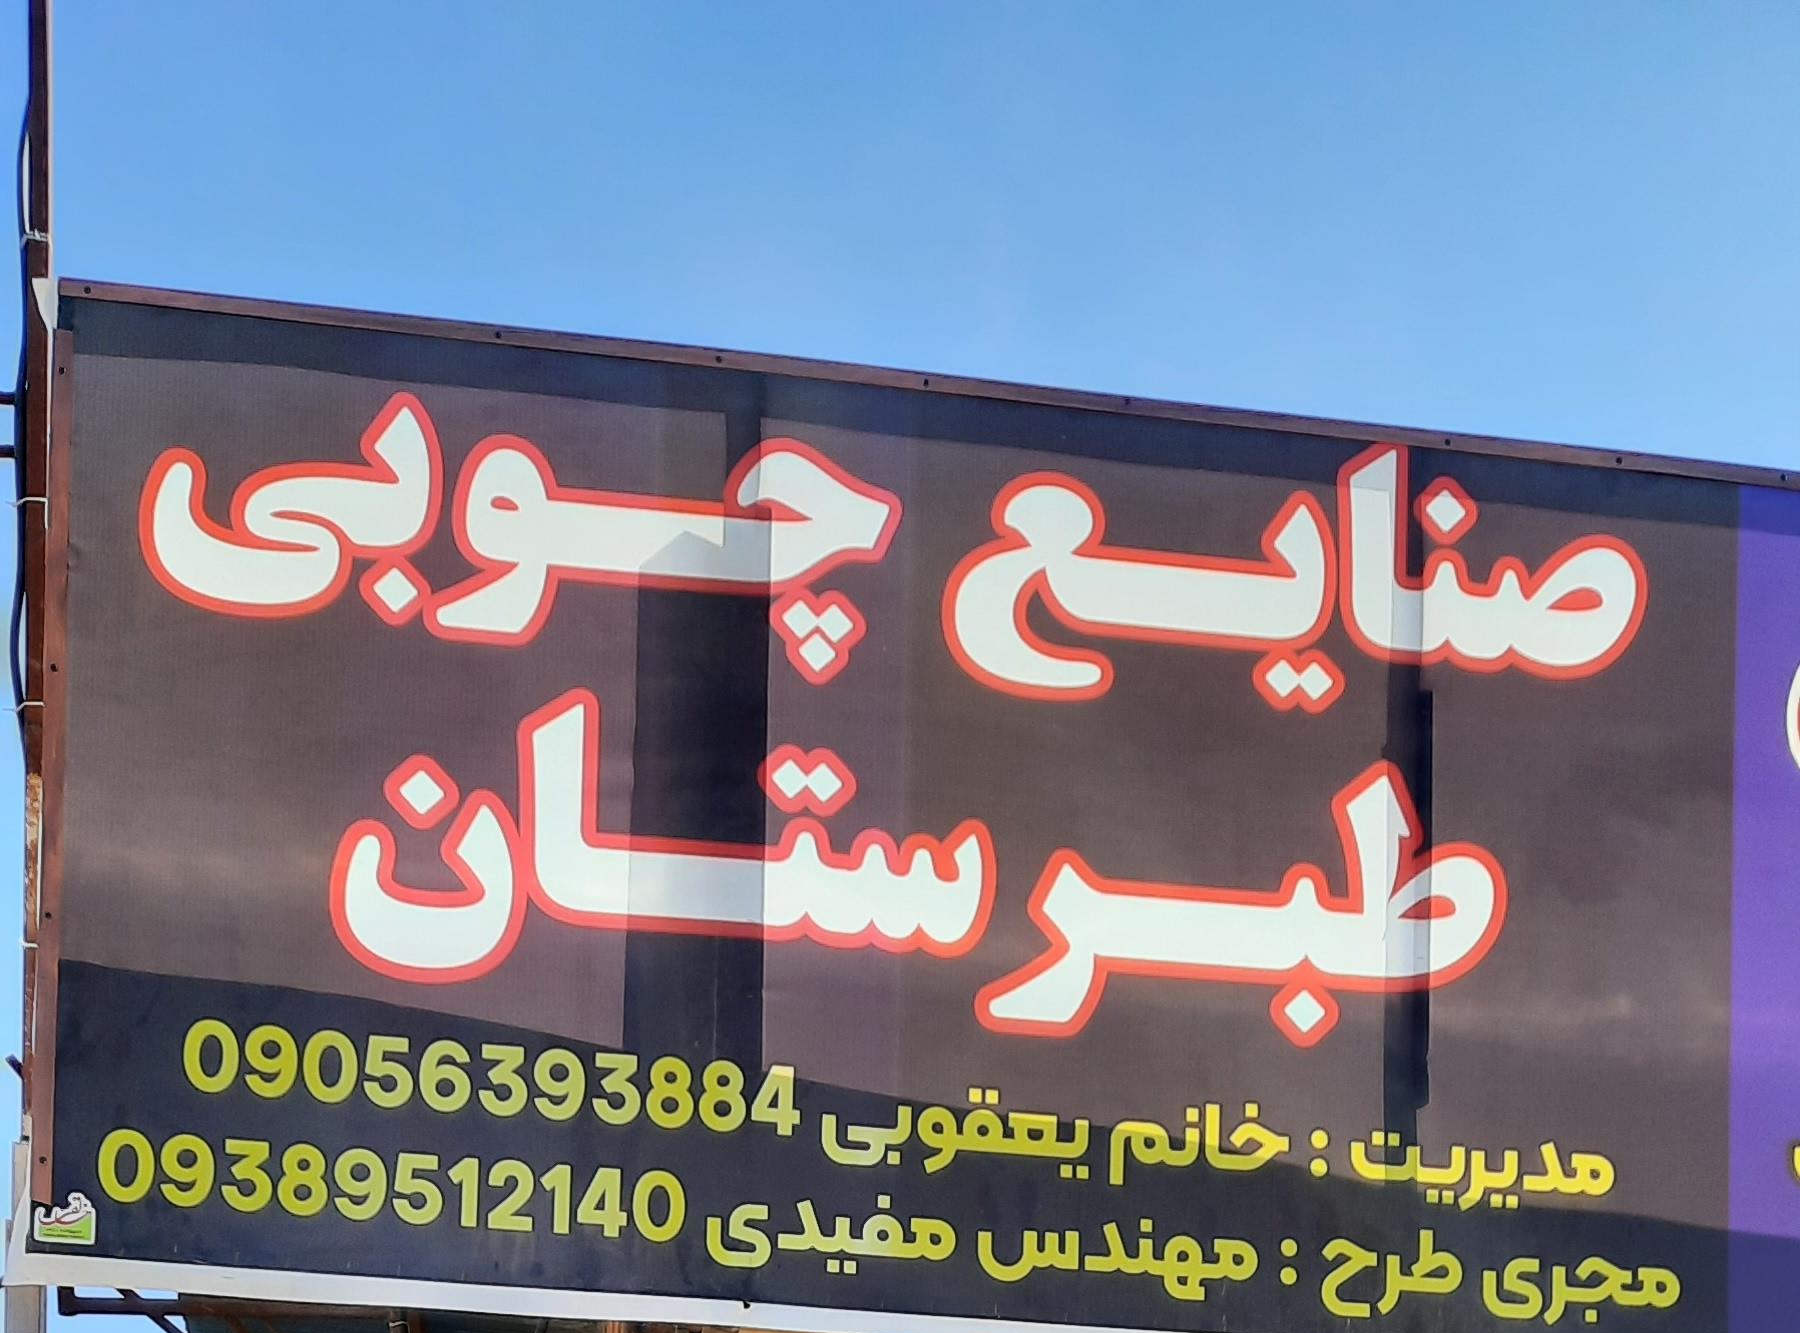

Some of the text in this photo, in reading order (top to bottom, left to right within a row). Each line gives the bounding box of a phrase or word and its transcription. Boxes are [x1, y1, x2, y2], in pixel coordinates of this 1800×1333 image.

[138, 391, 902, 684] چوبی
[941, 441, 1648, 714] صنایع
[329, 686, 1507, 1048] طبرستان
[182, 1018, 801, 1137] 09056393884
[820, 1086, 1091, 1181] یعقوبی
[1108, 1100, 1290, 1186] خانم
[1349, 1128, 1617, 1212] مدیریت
[96, 1127, 686, 1243] 09389512140
[705, 1193, 958, 1276] مفیدی
[976, 1217, 1260, 1303] مهندس
[1320, 1228, 1464, 1319] طرح
[1481, 1253, 1682, 1325] مجری
